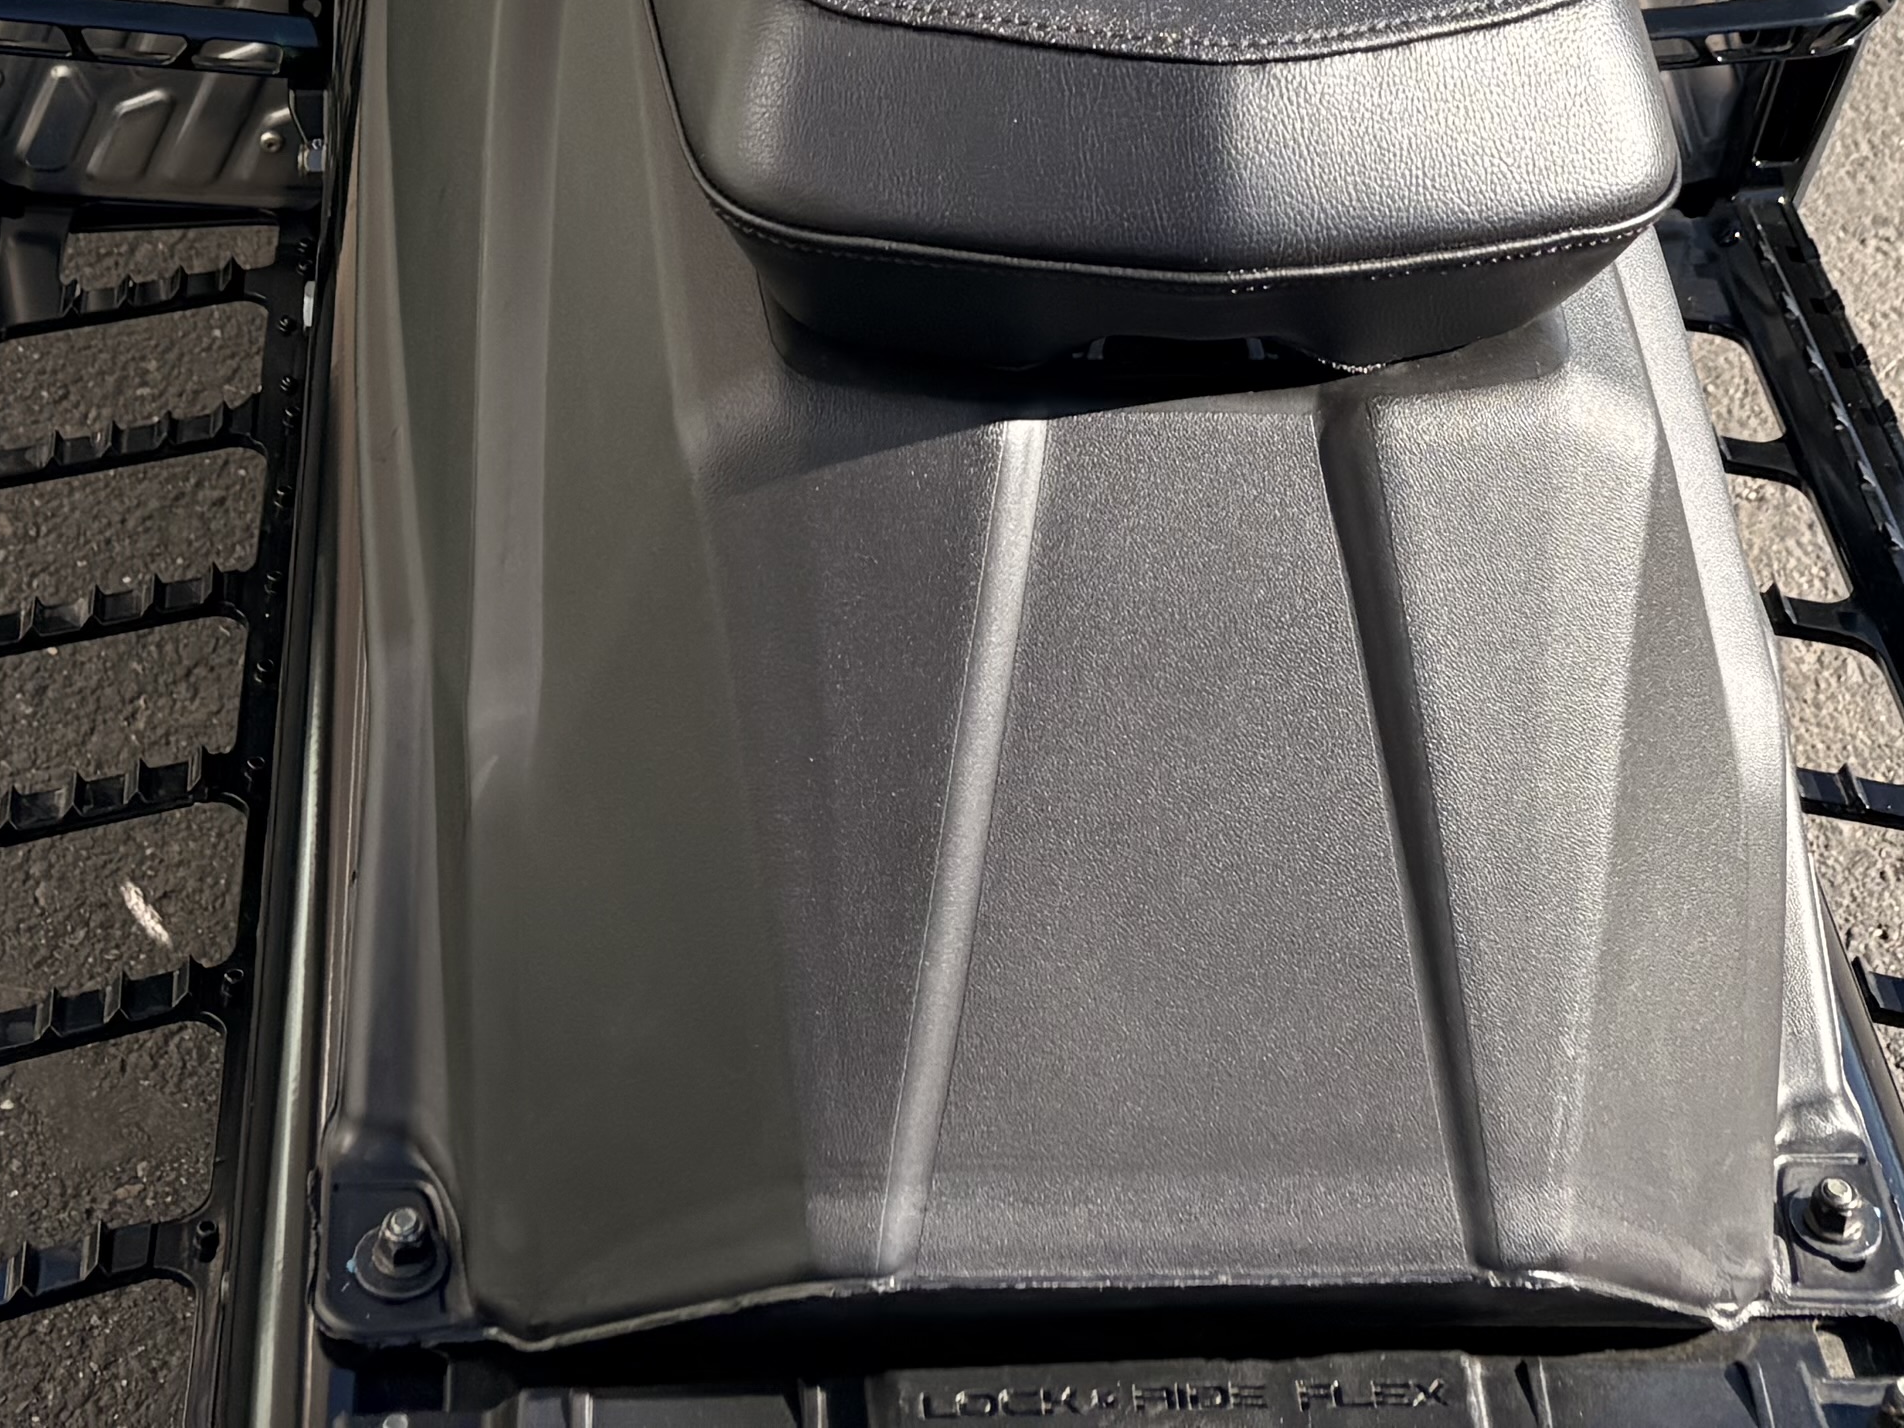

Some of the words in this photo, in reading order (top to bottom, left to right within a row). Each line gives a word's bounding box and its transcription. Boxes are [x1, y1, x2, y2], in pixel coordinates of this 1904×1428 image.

[919, 1387, 1078, 1419] LOCK
[1132, 1382, 1268, 1412] RIDE
[1295, 1377, 1452, 1412] FLEX
